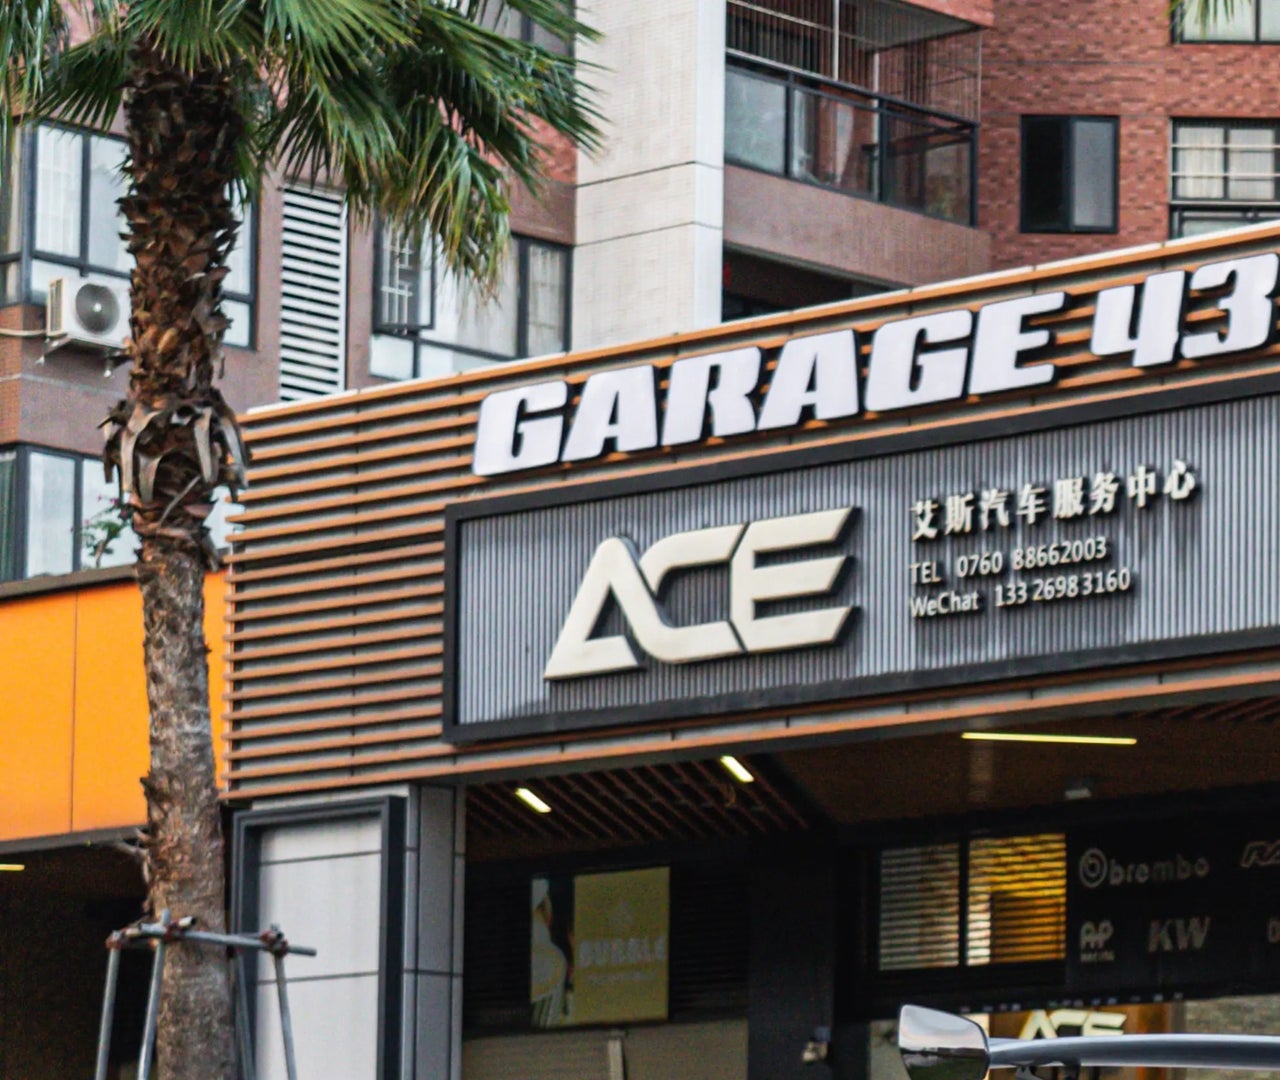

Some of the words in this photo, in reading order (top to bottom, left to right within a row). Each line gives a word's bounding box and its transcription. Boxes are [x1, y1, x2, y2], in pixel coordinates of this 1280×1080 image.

[472, 290, 1068, 477] GARAGE
[911, 459, 1196, 542] 艾斯汽车服务中心
[910, 561, 941, 585] TEL
[957, 551, 1003, 578] 0760
[1012, 536, 1107, 571] 88662003
[543, 505, 862, 682] ACE
[910, 591, 979, 618] WeChat
[1109, 854, 1210, 886] brembo
[1149, 915, 1211, 953] KW
